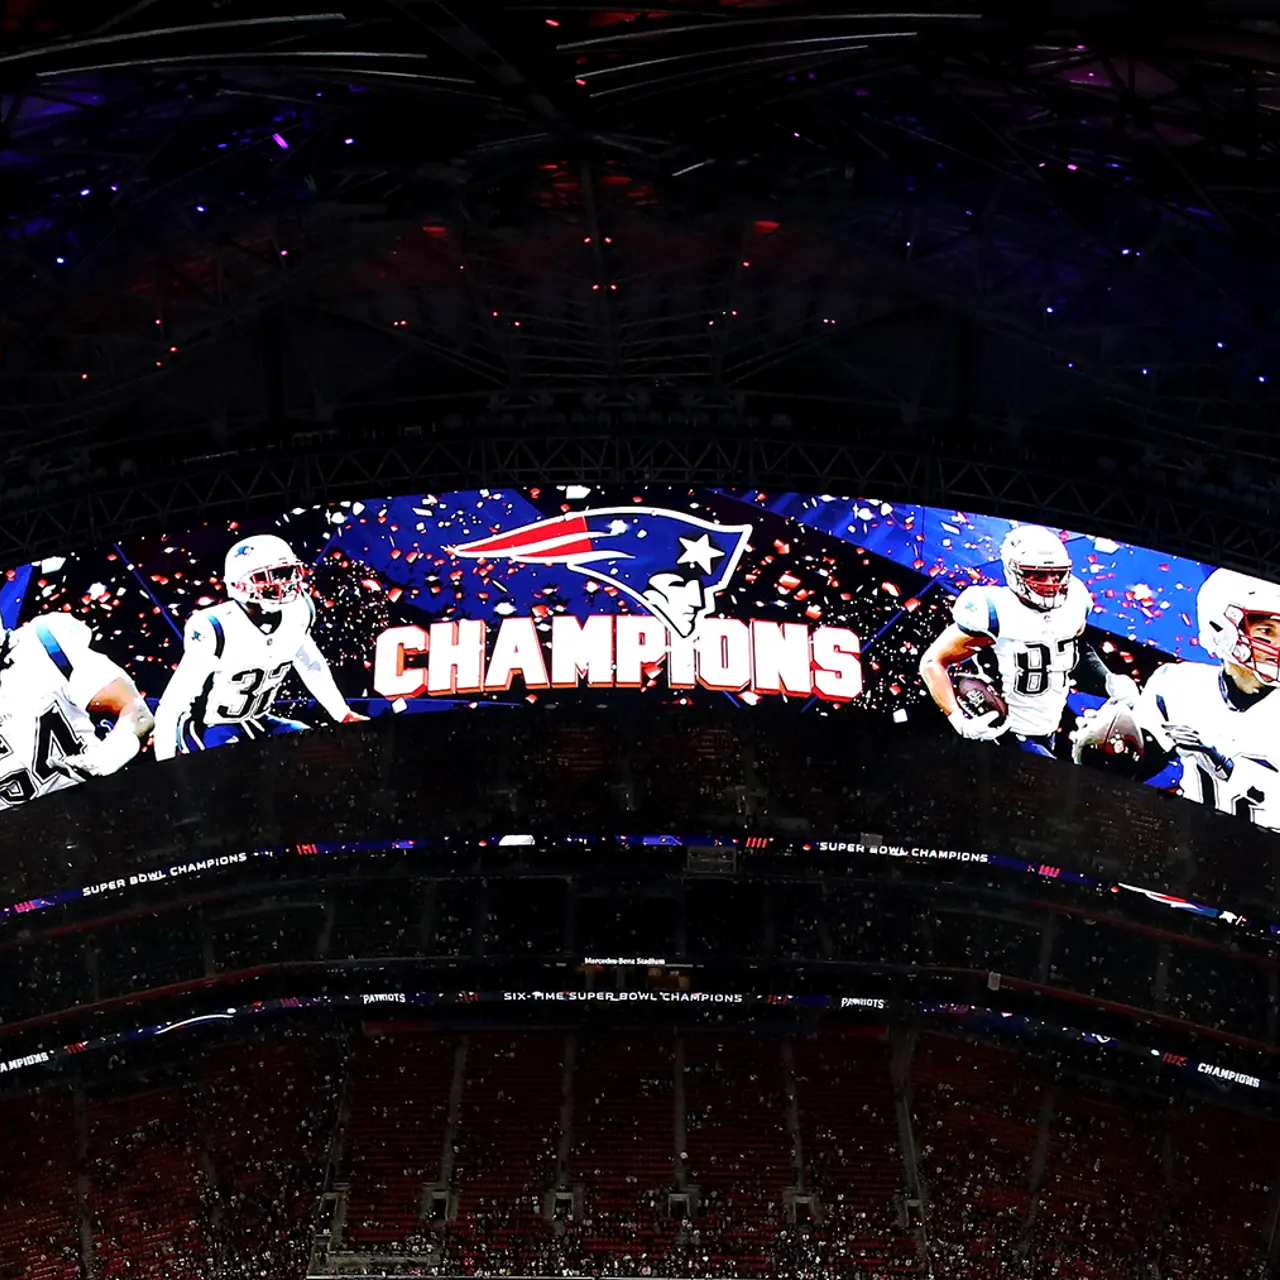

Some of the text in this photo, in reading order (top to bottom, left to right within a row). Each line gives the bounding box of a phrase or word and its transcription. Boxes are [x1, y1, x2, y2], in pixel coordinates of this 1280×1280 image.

[373, 613, 864, 701] CHAMPIONS
[819, 842, 988, 863] SUPER BOWL CHAMPIONS
[82, 852, 248, 896] SUPER BOWL CHAMPIONS
[636, 957, 665, 965] Stadium
[363, 993, 406, 1005] PATRIOTS
[503, 991, 743, 1003] SIX-TIME SUPER BOWL CHAMPIONS
[841, 997, 884, 1009] PATRIOTS
[1197, 1062, 1260, 1088] CHAMPIONS
